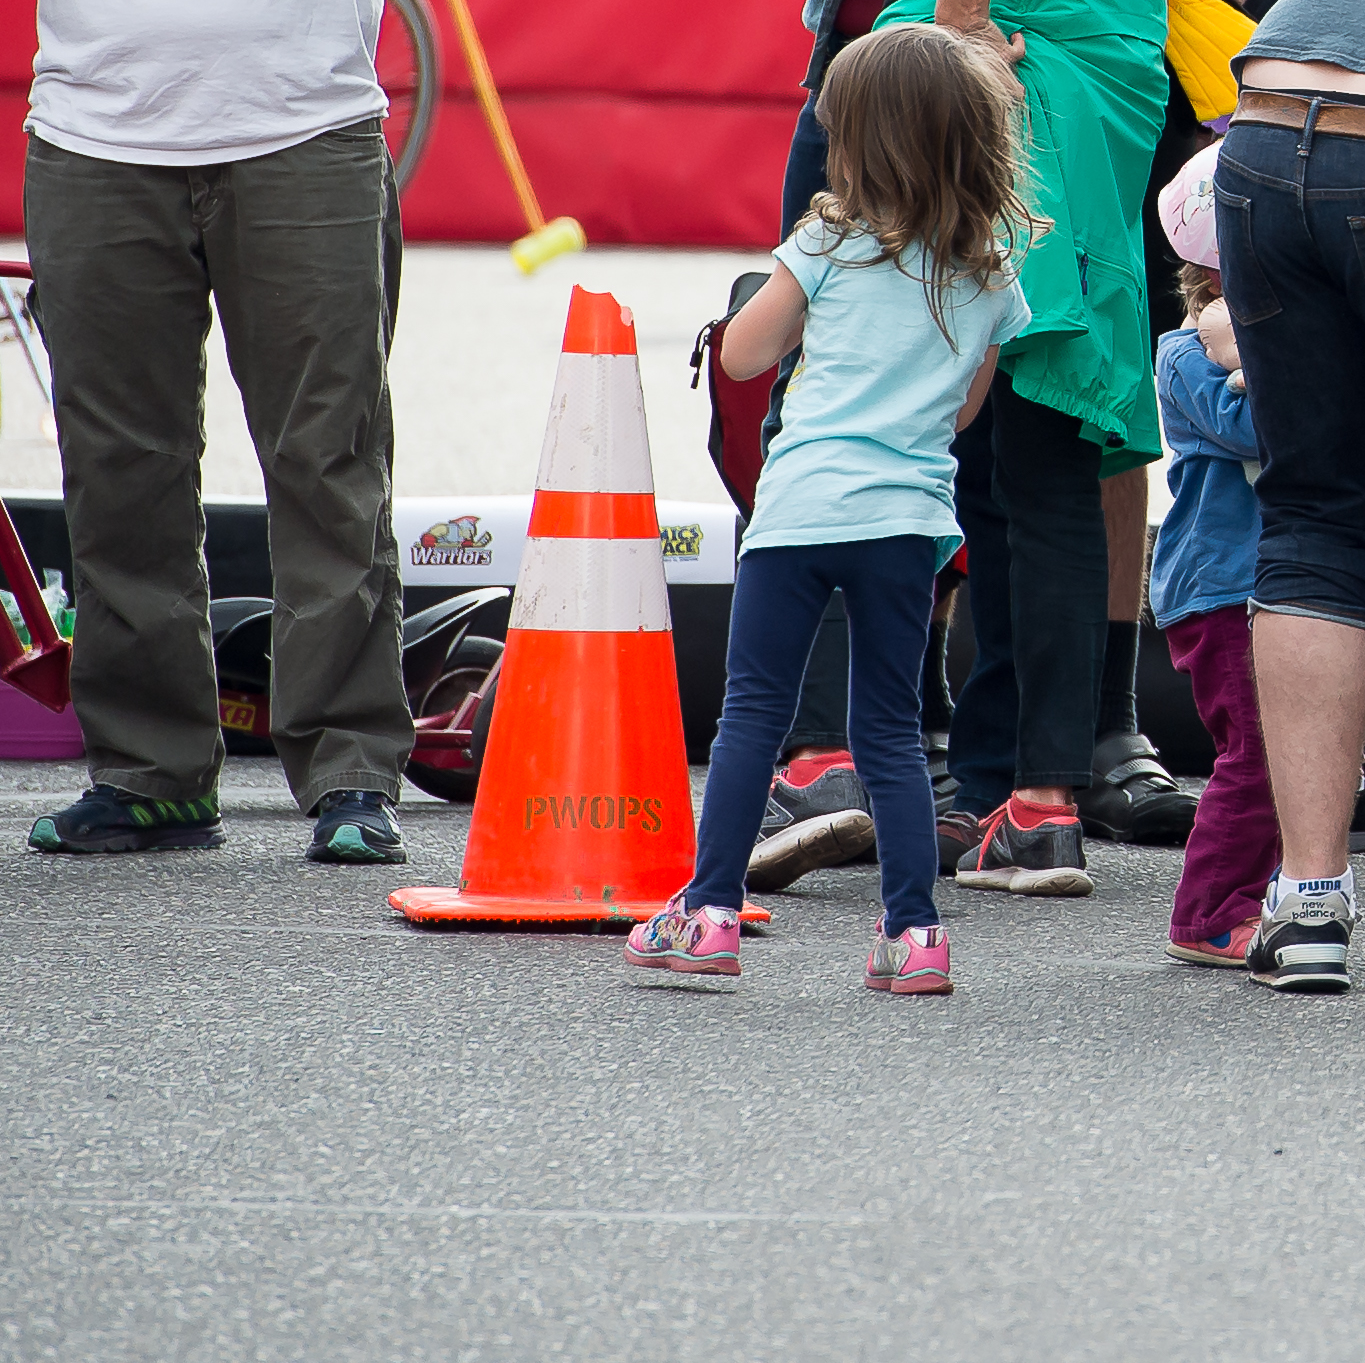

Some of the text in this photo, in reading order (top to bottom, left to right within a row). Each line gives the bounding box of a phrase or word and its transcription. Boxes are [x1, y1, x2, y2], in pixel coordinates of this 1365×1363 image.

[410, 545, 492, 566] Warriors
[524, 796, 663, 833] PWOPS
[1298, 879, 1342, 893] PUMA
[1301, 900, 1326, 910] new
[1292, 909, 1336, 921] balance
